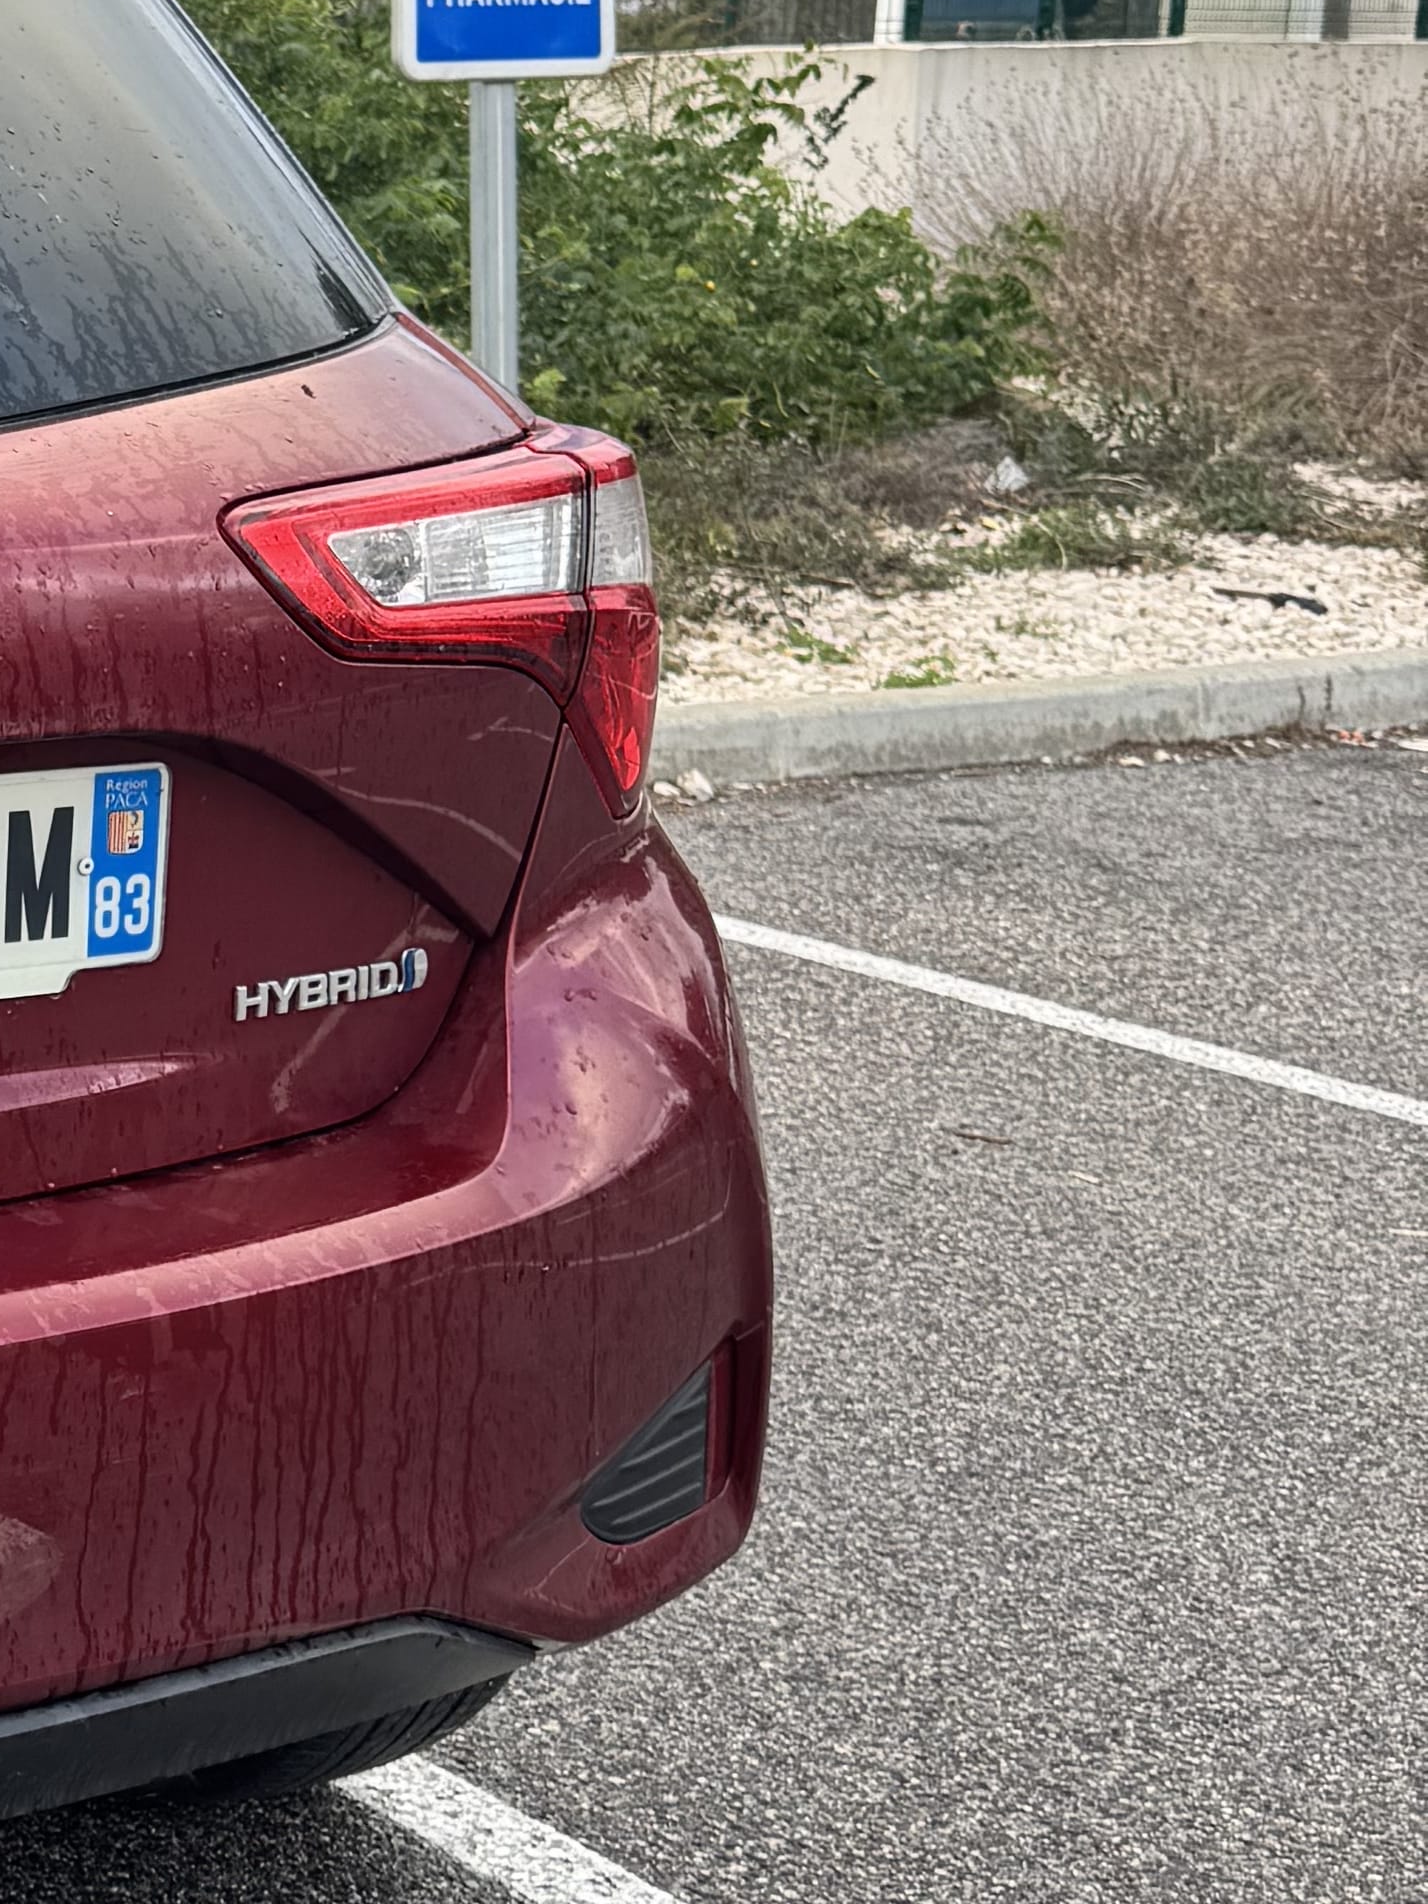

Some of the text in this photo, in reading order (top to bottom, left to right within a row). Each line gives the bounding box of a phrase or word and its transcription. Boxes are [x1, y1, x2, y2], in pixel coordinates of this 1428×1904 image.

[105, 791, 148, 809] PACA
[94, 873, 151, 938] 83
[235, 961, 400, 1022] HYBRID
